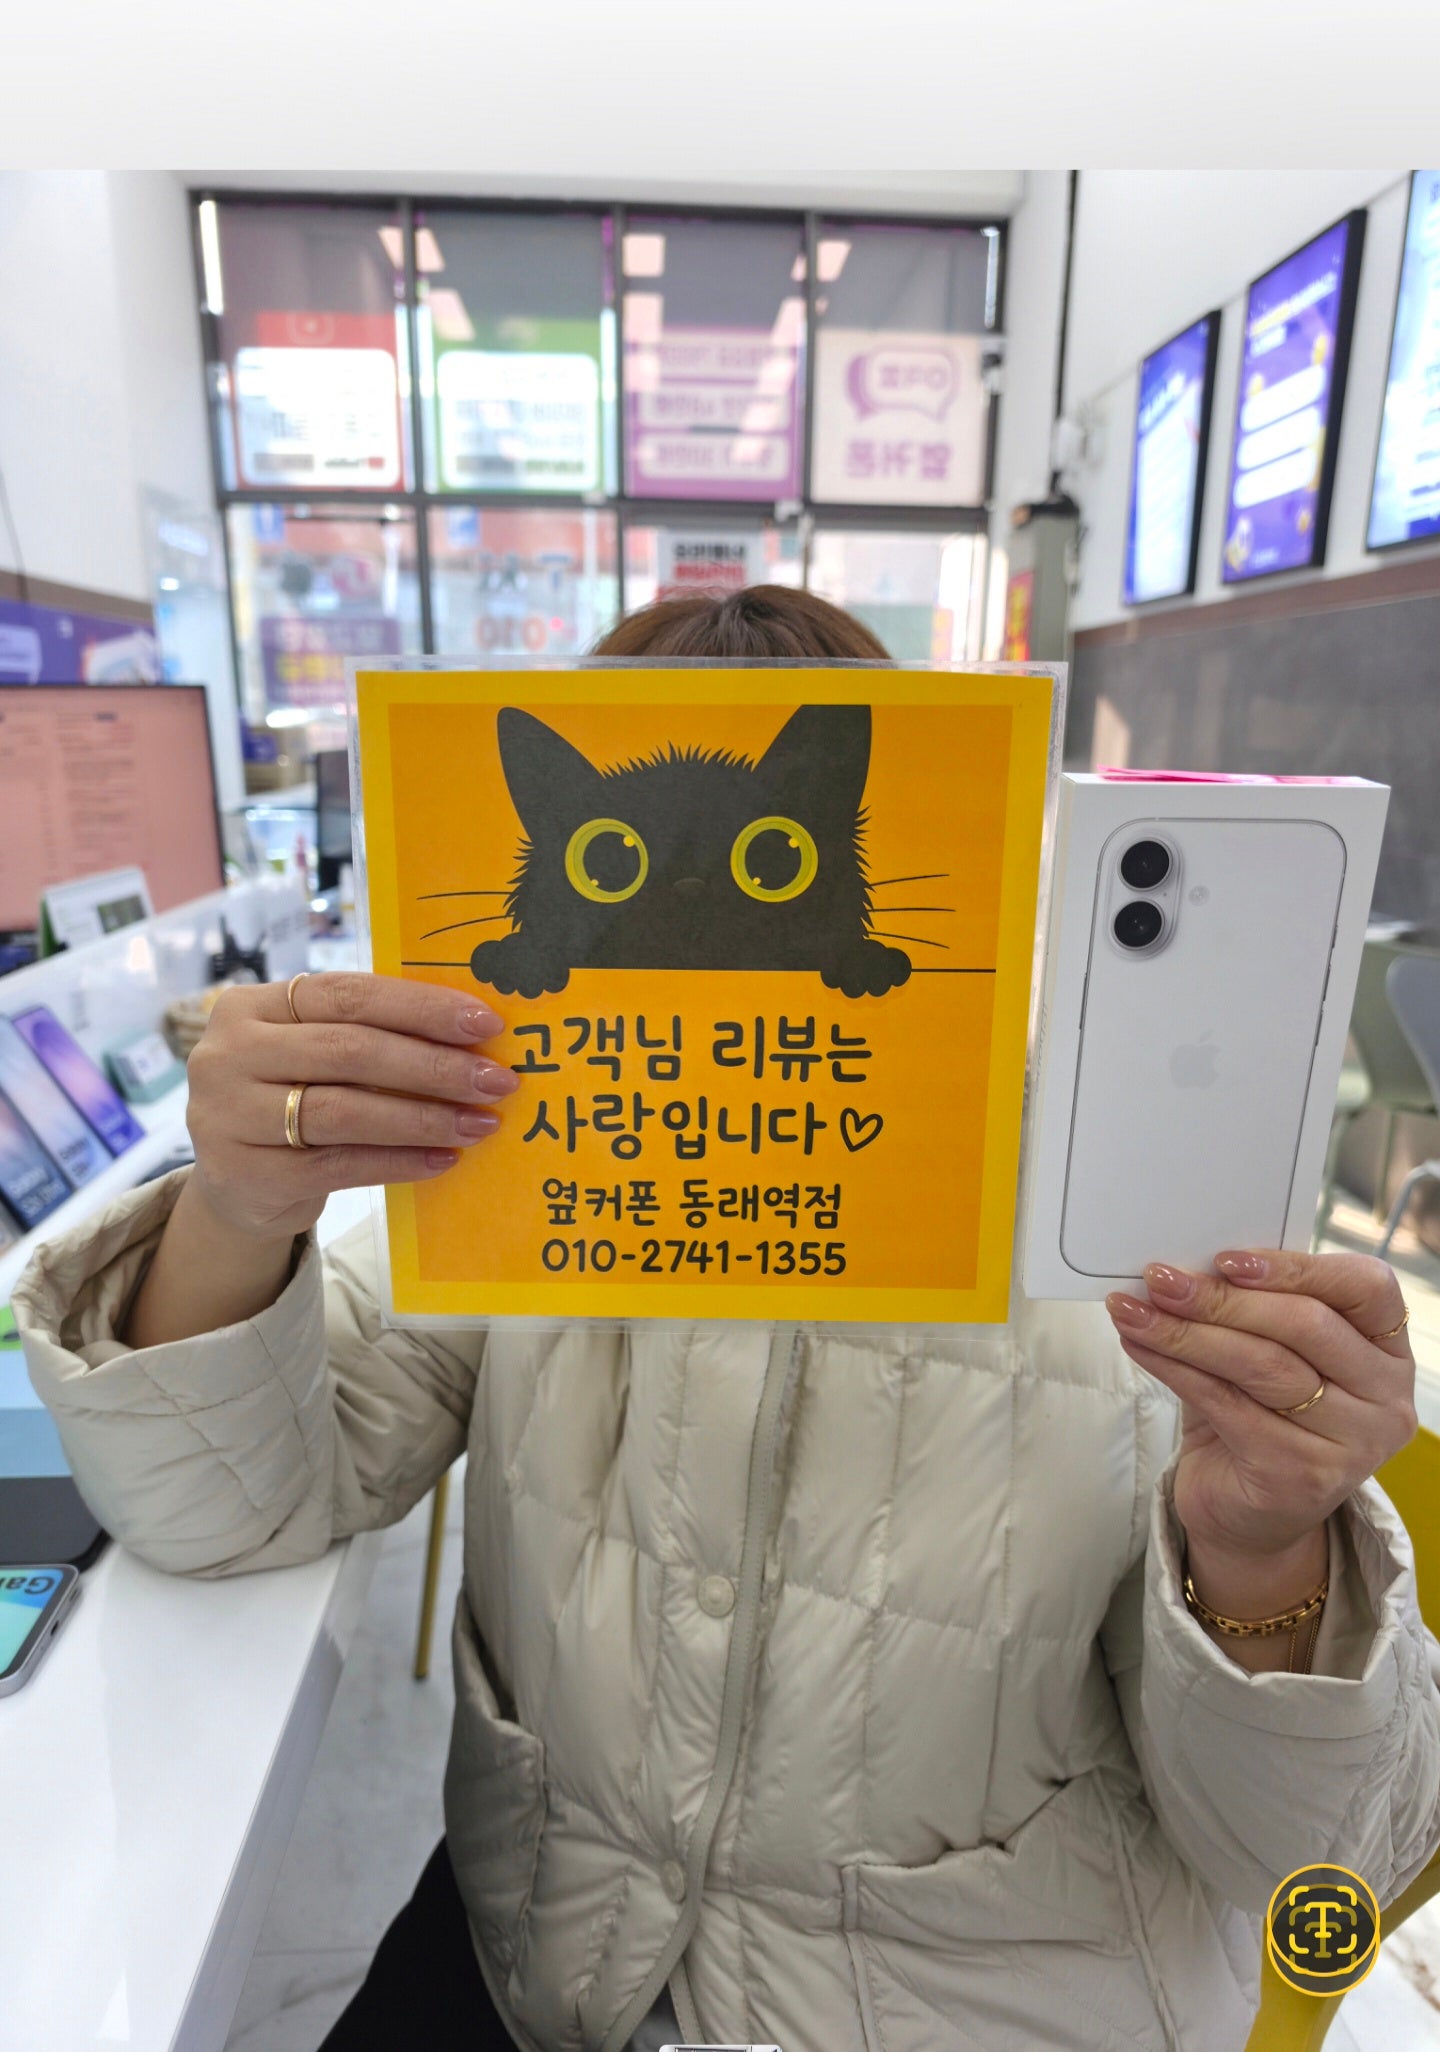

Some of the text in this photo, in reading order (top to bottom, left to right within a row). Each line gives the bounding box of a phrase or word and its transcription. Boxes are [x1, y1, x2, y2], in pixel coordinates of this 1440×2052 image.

[510, 1014, 873, 1083] 고객님 리뷰는
[522, 1091, 828, 1161] 사랑입니다
[542, 1177, 841, 1230] 옆커폰 동래역점
[541, 1238, 847, 1276] 010-2741-1355
